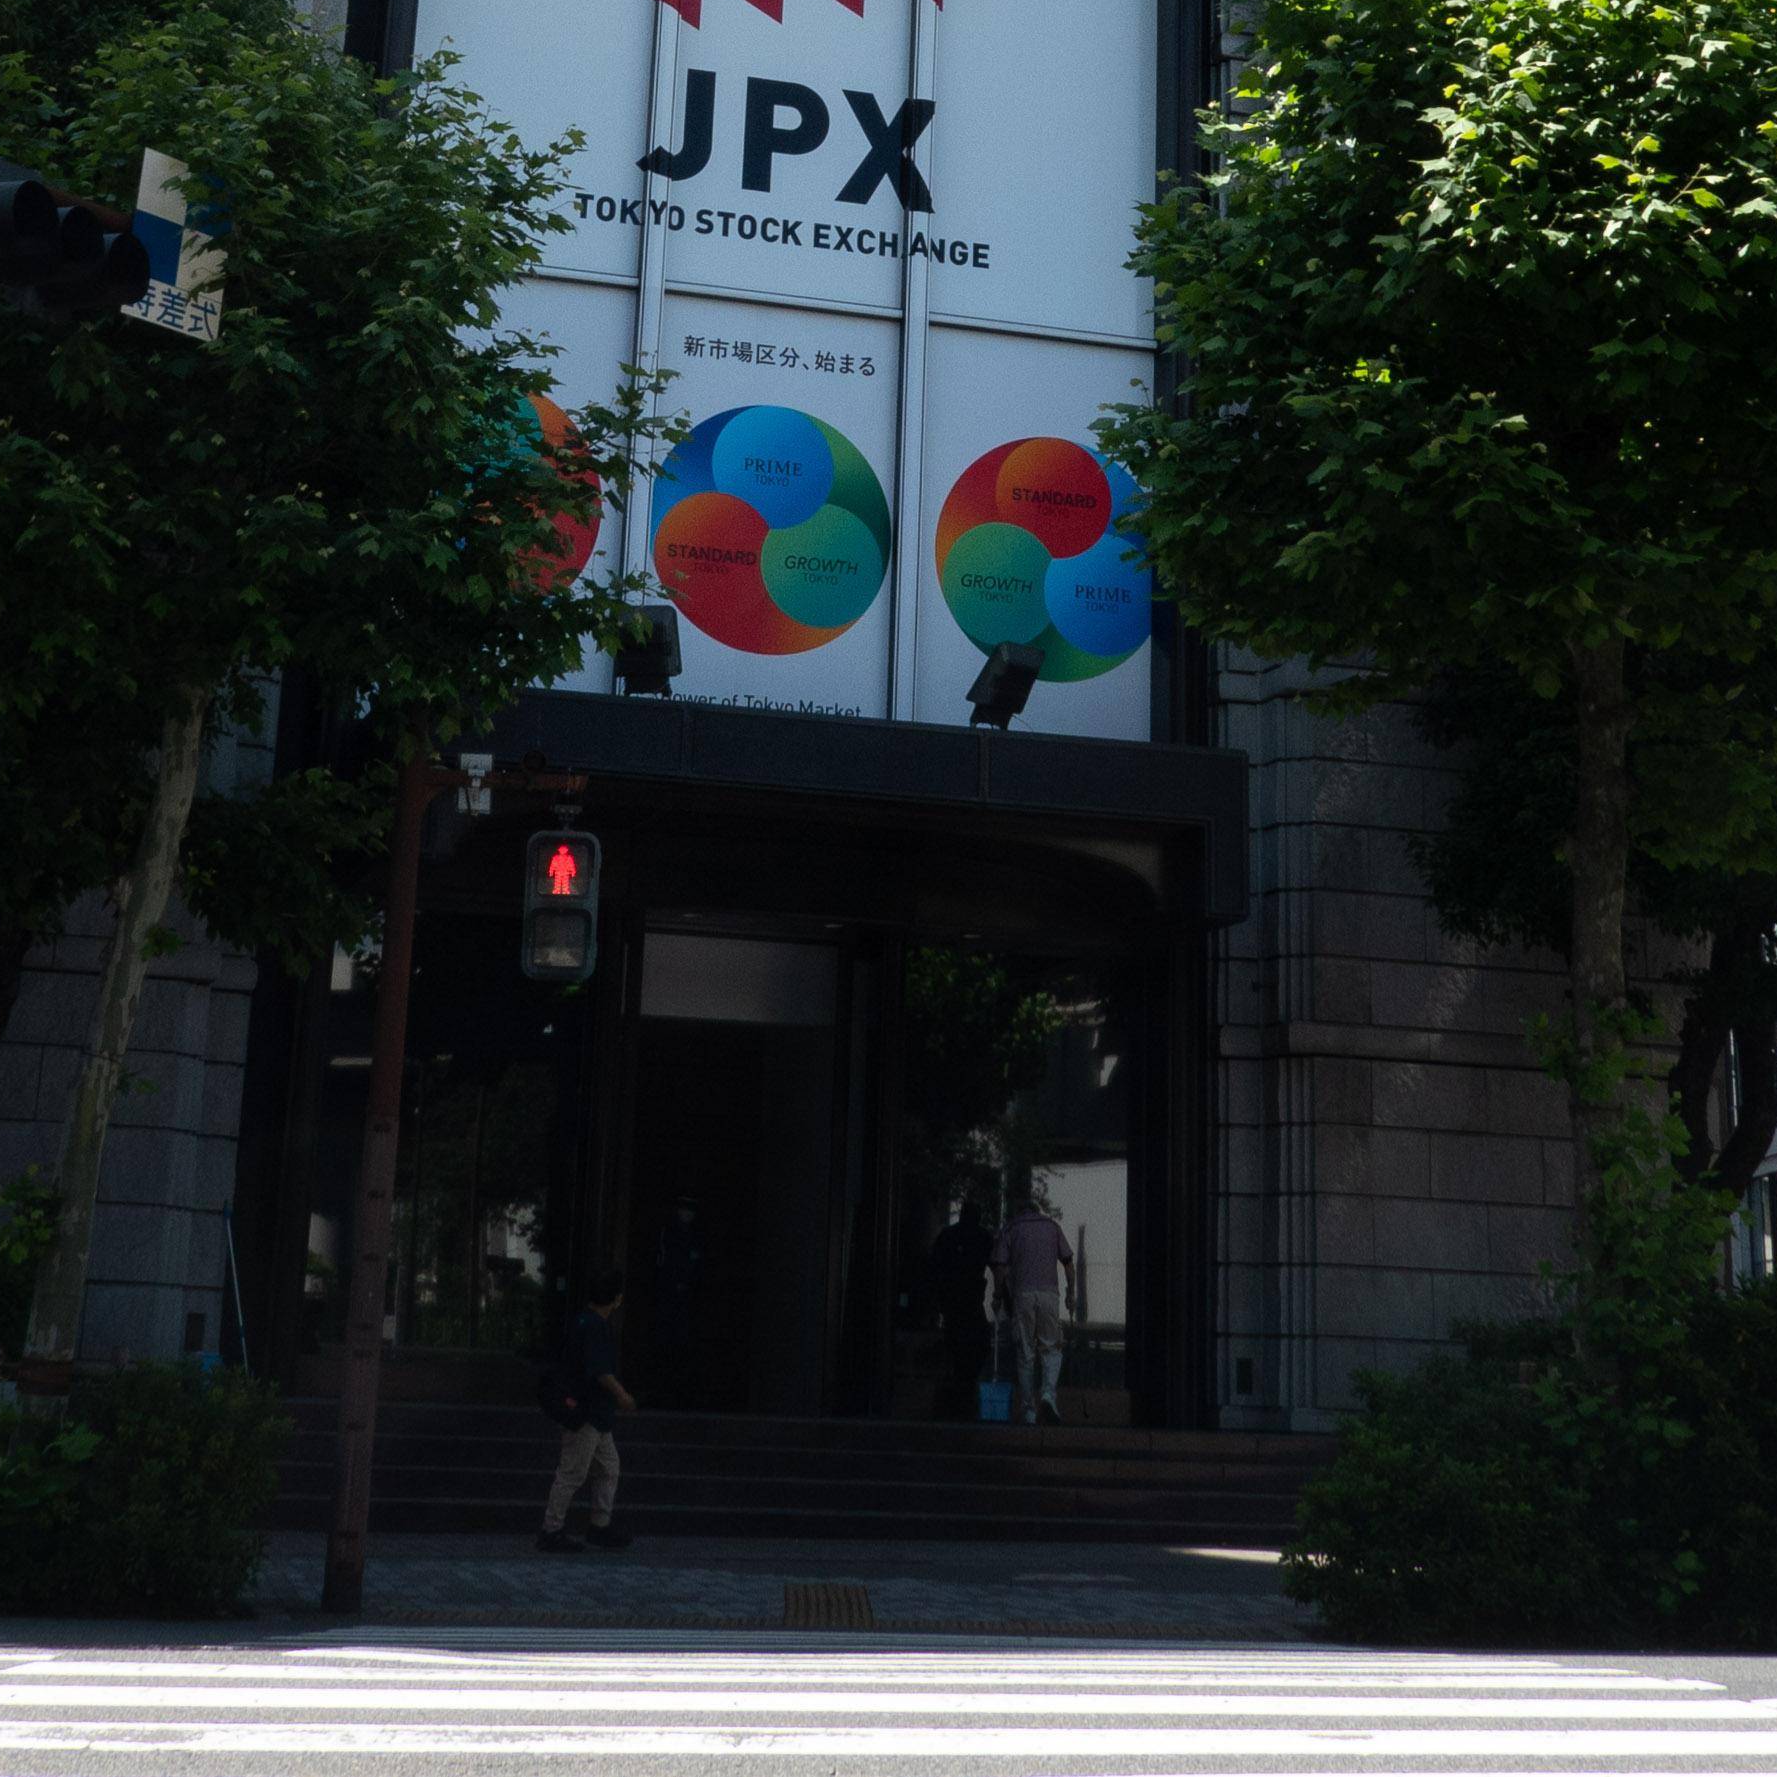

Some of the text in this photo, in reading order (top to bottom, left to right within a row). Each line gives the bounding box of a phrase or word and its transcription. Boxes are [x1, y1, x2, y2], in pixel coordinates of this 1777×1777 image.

[635, 68, 937, 214] JPX
[575, 192, 991, 269] TOKYO STOCK EXCHANGE
[683, 334, 877, 377] 新市場区分、始まる
[744, 457, 803, 477] PRIME
[755, 474, 790, 487] TOKYO
[1011, 487, 1098, 509] STANDARD
[667, 543, 758, 566] STANDARD
[784, 555, 859, 575] GROWTH
[803, 572, 839, 585] TOKYO
[960, 573, 1034, 594] GROWTH
[979, 591, 1014, 604] TOKYO
[1074, 584, 1132, 604] PRIME
[1085, 601, 1120, 613] TOKYO
[671, 692, 717, 705] ower
[721, 694, 738, 708] of
